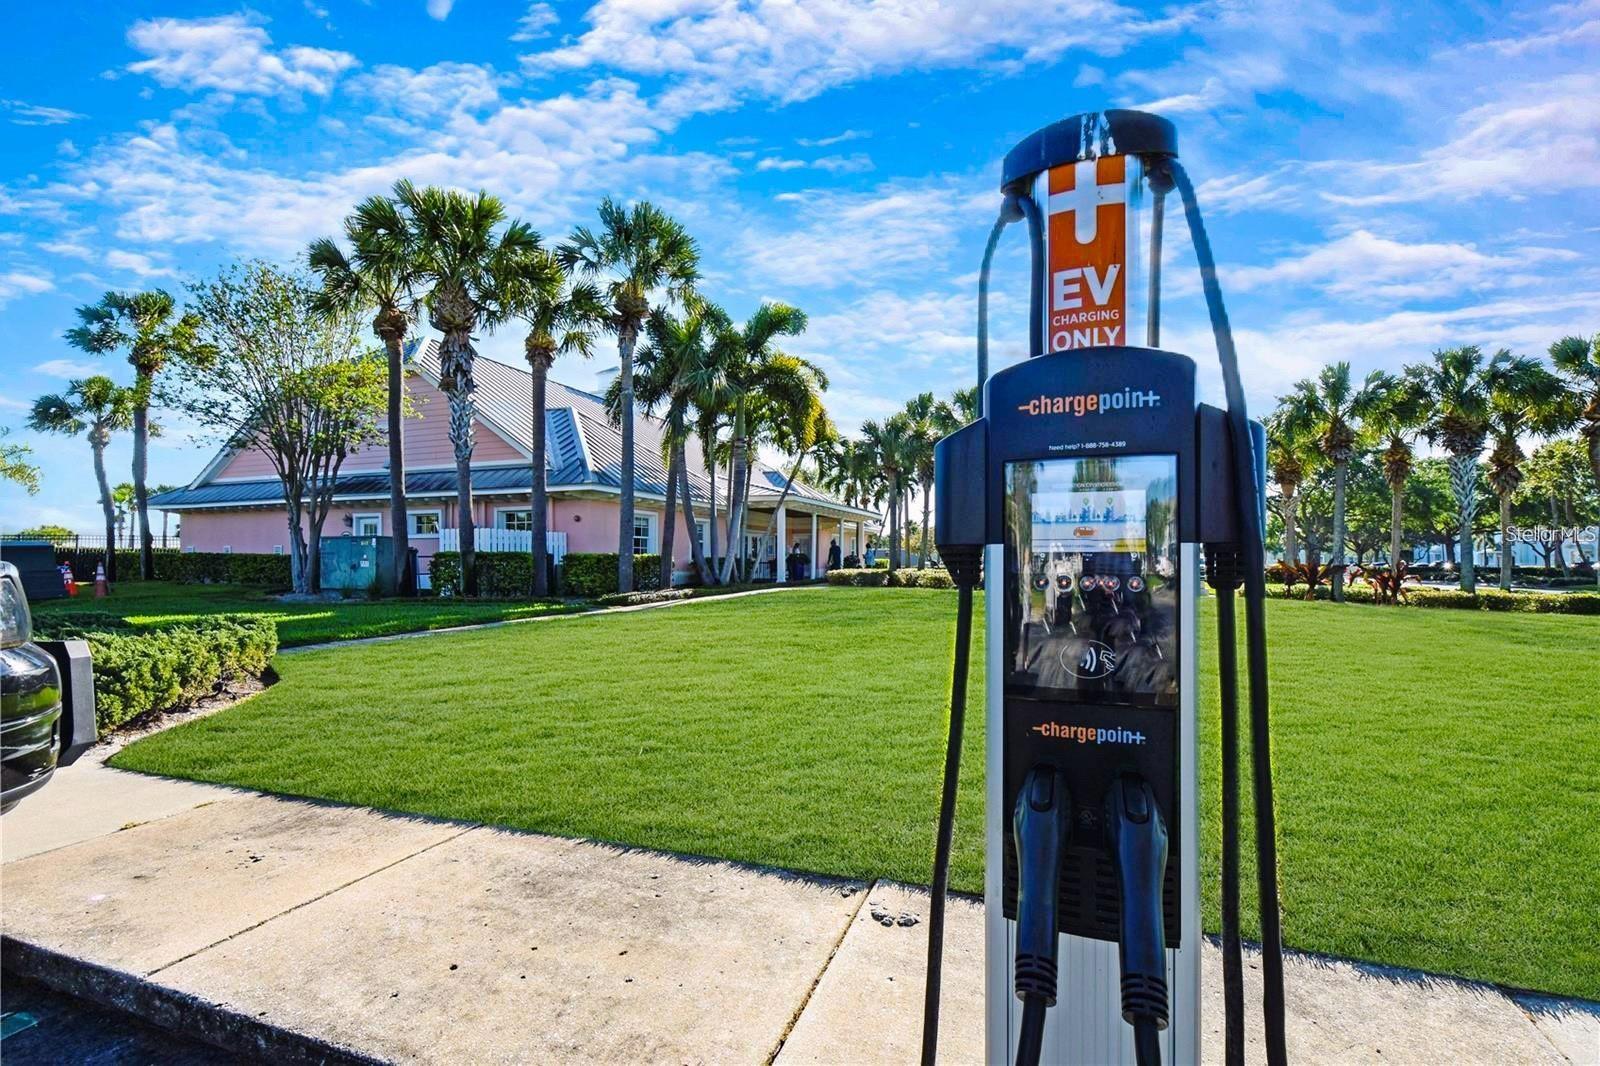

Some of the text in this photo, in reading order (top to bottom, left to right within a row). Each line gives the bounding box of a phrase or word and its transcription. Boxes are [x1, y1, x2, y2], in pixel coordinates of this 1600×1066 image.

[1053, 263, 1121, 311] EV
[1053, 309, 1119, 326] CHARGING
[1053, 325, 1121, 352] ONLY
[1065, 443, 1079, 451] help?
